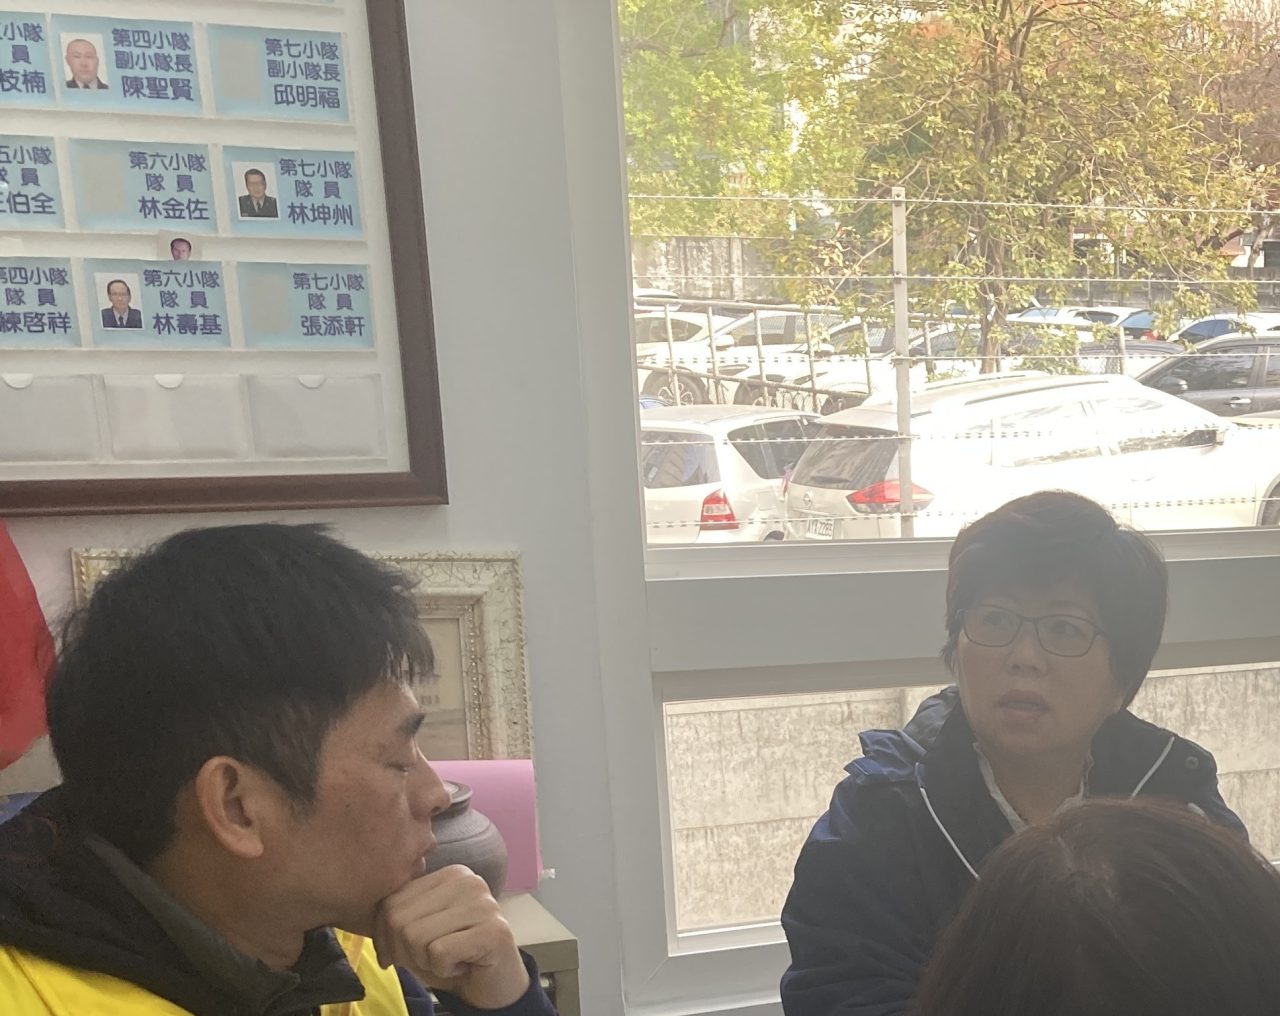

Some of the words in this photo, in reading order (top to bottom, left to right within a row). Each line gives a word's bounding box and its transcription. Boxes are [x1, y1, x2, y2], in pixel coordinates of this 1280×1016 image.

[0, 22, 44, 42] 小隊
[111, 27, 192, 51] 第四小隊
[264, 38, 340, 61] 第七小隊
[114, 50, 194, 73] 副小隊長
[266, 59, 342, 82] 副小隊長
[121, 75, 195, 101] 陳聖賢
[273, 83, 341, 108] 邱明福
[128, 150, 207, 172] 第六小隊
[278, 158, 353, 179] 第七小隊
[138, 195, 210, 220] 林金佐
[287, 202, 354, 226] 林坤州
[143, 269, 221, 289] 第六小隊
[292, 272, 366, 292] 第七小隊
[152, 313, 223, 336] 林壽基
[300, 315, 366, 337] 張添軒
